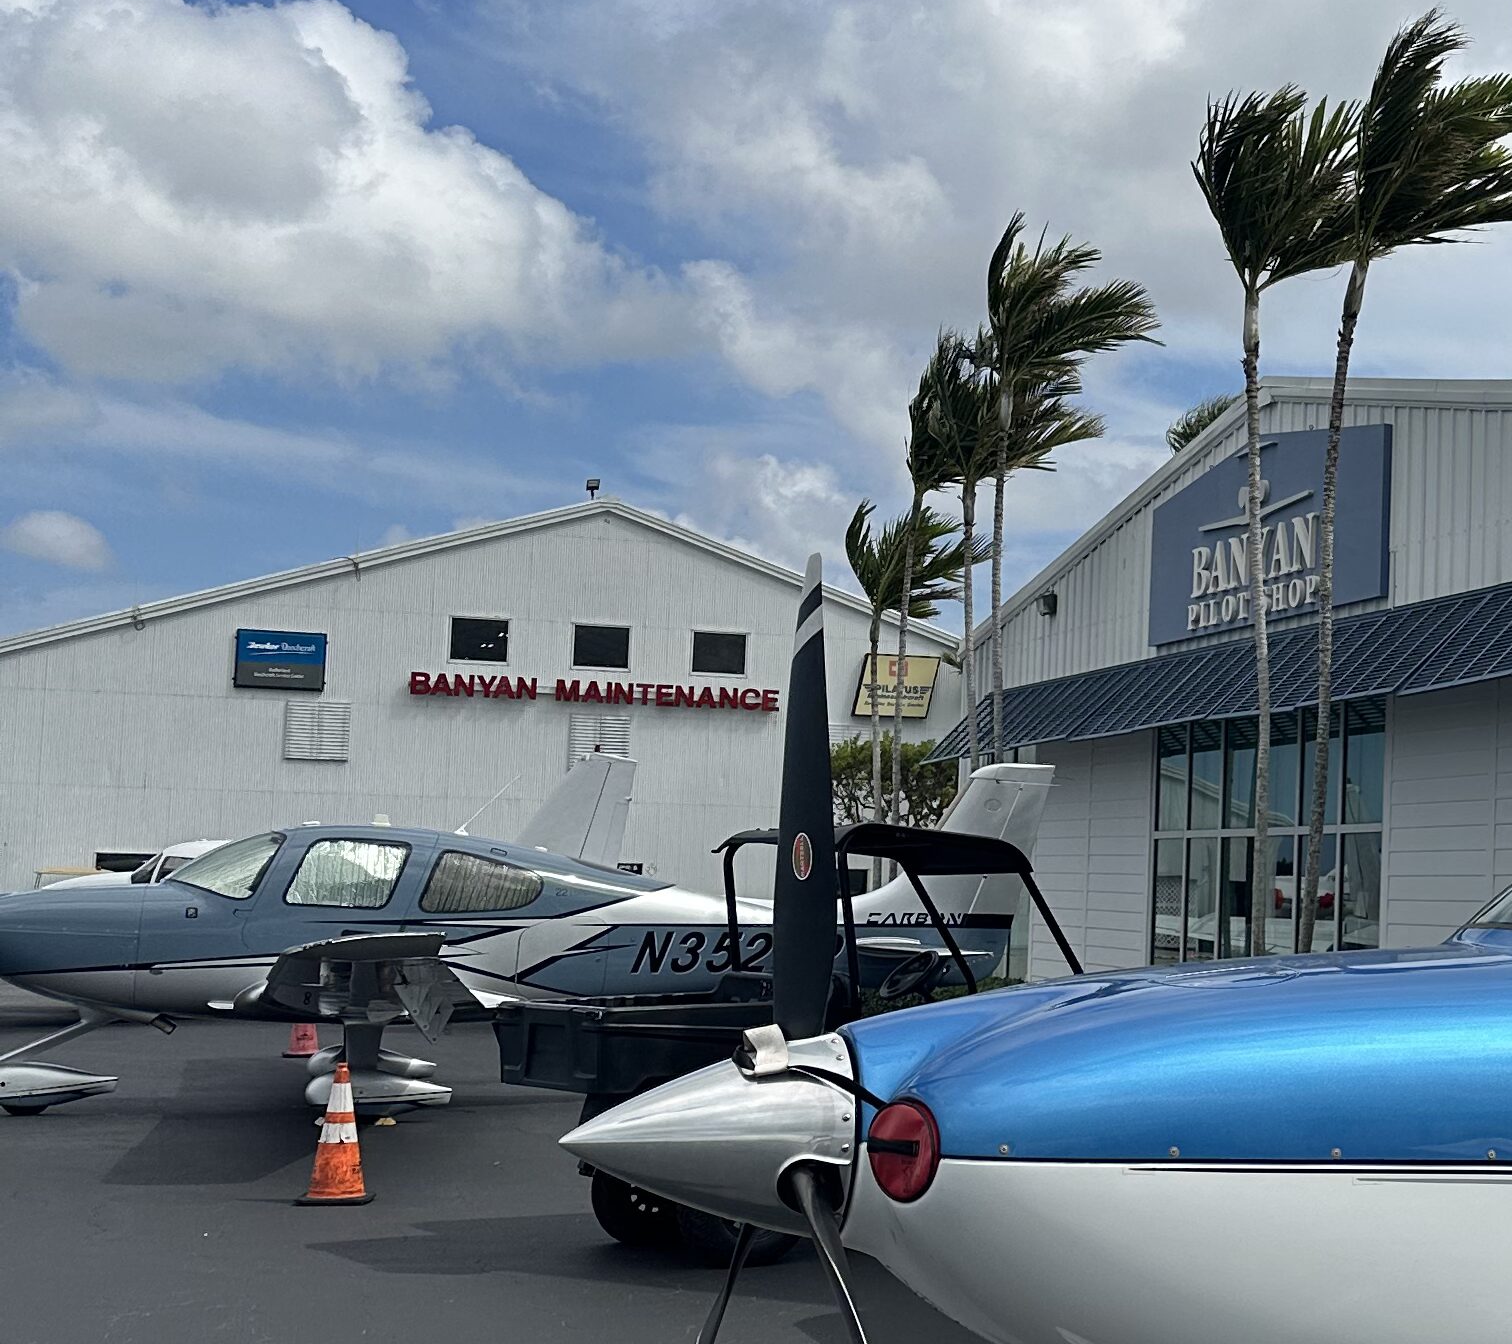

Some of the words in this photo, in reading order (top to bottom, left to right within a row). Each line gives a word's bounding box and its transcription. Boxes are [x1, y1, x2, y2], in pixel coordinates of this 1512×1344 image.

[1187, 592, 1251, 630] PILOT
[409, 671, 538, 700] BANYAN
[555, 679, 780, 712] MAINTENANCE
[874, 684, 919, 695] PILAUS
[631, 931, 846, 974] N352
